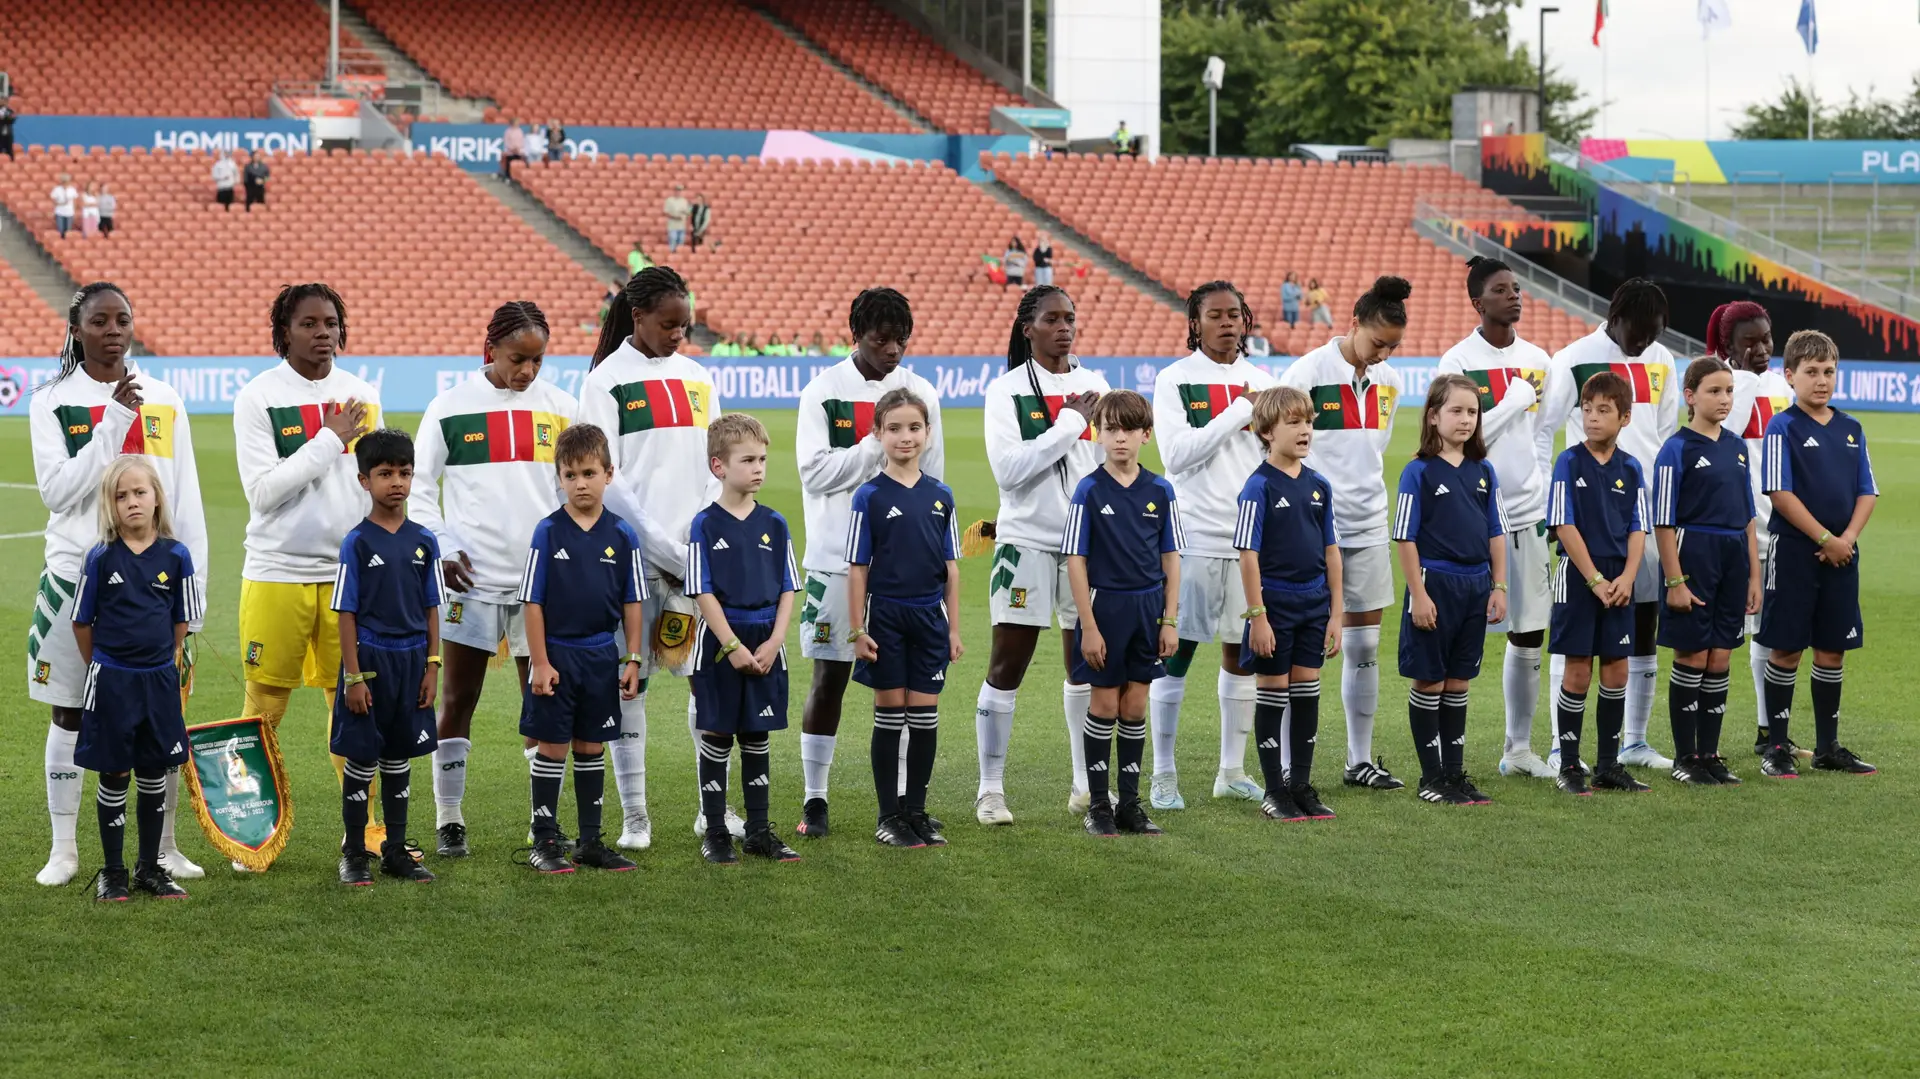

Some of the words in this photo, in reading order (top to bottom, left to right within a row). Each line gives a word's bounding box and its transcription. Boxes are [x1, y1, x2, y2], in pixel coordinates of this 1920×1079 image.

[154, 130, 308, 157] HAMILTON
[706, 365, 802, 399] OOTBALL
[1850, 370, 1907, 402] UNITES
[1478, 386, 1489, 394] ne
[627, 399, 646, 410] one
[1190, 401, 1208, 410] one
[1322, 402, 1340, 410] one
[835, 419, 852, 428] one
[68, 424, 89, 435] one
[281, 425, 302, 436] one
[464, 432, 484, 442] one
[442, 760, 465, 771] one
[50, 771, 77, 780] one
